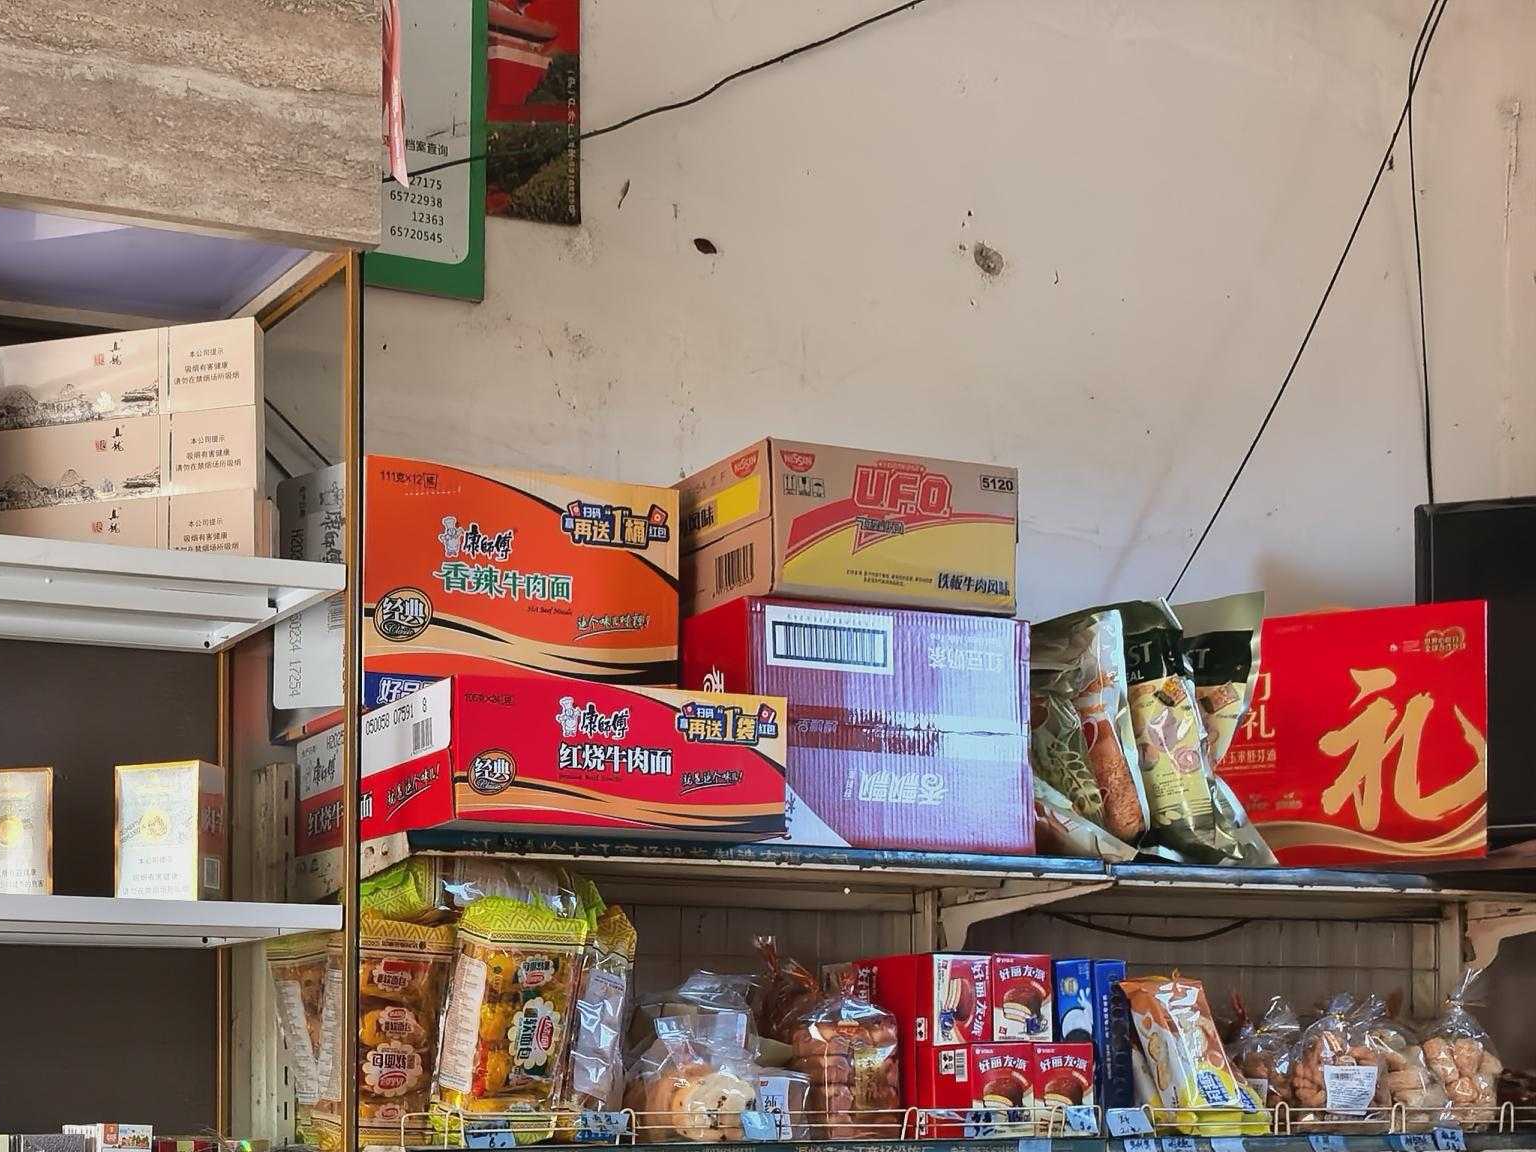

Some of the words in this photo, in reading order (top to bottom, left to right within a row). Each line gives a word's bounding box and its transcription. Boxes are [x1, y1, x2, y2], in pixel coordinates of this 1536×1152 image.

[390, 189, 443, 209] 65722938
[413, 211, 444, 227] 12363
[389, 225, 443, 244] 65720545
[188, 347, 225, 358] 本公司提示
[184, 361, 229, 374] 吸烟有害健康
[173, 371, 241, 386] 请勿在禁烟场所吸烟
[190, 434, 225, 445] 本公司提示
[186, 448, 230, 460] 吸烟有害健康
[175, 459, 242, 472] 请勿在禁烟场所吸烟
[981, 475, 1014, 492] 5120
[583, 506, 601, 519] 扫码
[188, 517, 224, 528] 本公司提示
[183, 531, 228, 543] 吸烟有害健康
[648, 526, 667, 539] 红包
[434, 561, 573, 602] 香辣牛肉面
[937, 570, 1009, 597] 铁板牛肉风味
[382, 597, 426, 626] 经典
[421, 698, 428, 714] 8
[695, 706, 714, 718] 扫码
[757, 724, 775, 736] 红包
[1318, 667, 1486, 831] 礼
[559, 743, 673, 776] 红烧牛肉面
[472, 757, 513, 780] 经典
[859, 769, 947, 805] 香飘飘
[999, 965, 1046, 982] 好丽友·派
[978, 1055, 1027, 1073] 好丽友·派
[1039, 1055, 1088, 1072] 好丽友·派
